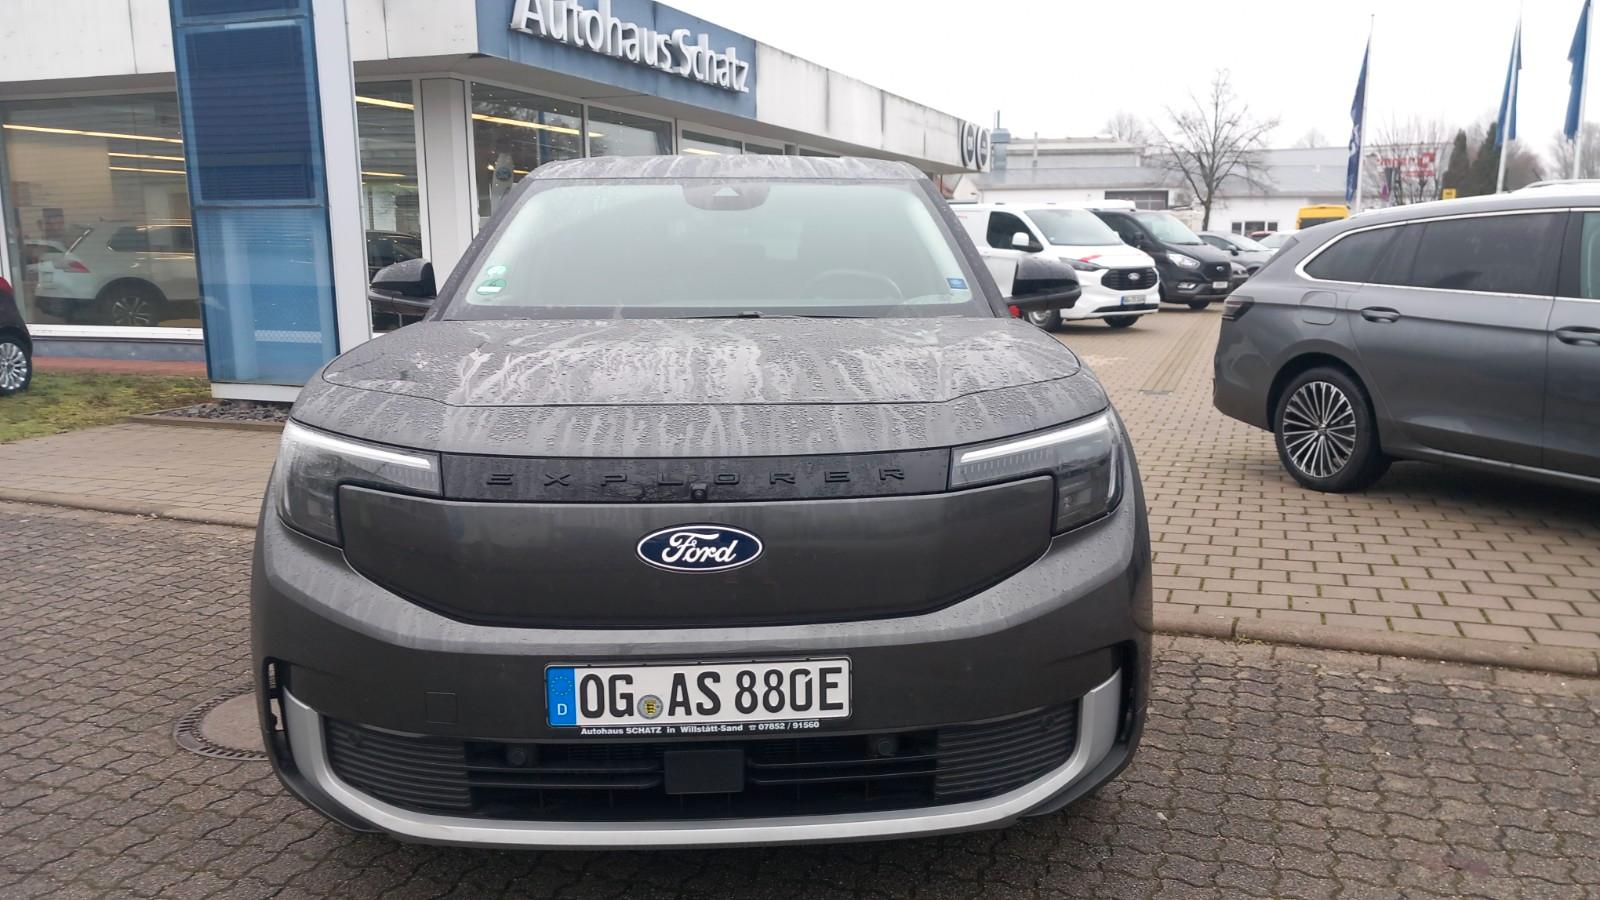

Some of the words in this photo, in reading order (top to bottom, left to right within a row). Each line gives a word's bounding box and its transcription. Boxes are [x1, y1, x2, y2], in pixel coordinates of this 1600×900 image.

[511, 0, 672, 70] Autohaus
[670, 28, 749, 93] Schatz
[486, 467, 905, 487] EXPLORER
[661, 530, 738, 563] Ford
[579, 673, 634, 719] OG
[667, 671, 721, 716] AS
[735, 666, 844, 714] 880E
[557, 703, 568, 716] D
[581, 727, 624, 735] Autohaus
[625, 726, 662, 735] SCHATZ
[667, 726, 676, 734] in
[758, 722, 785, 730] 07852
[792, 720, 820, 729] 91560
